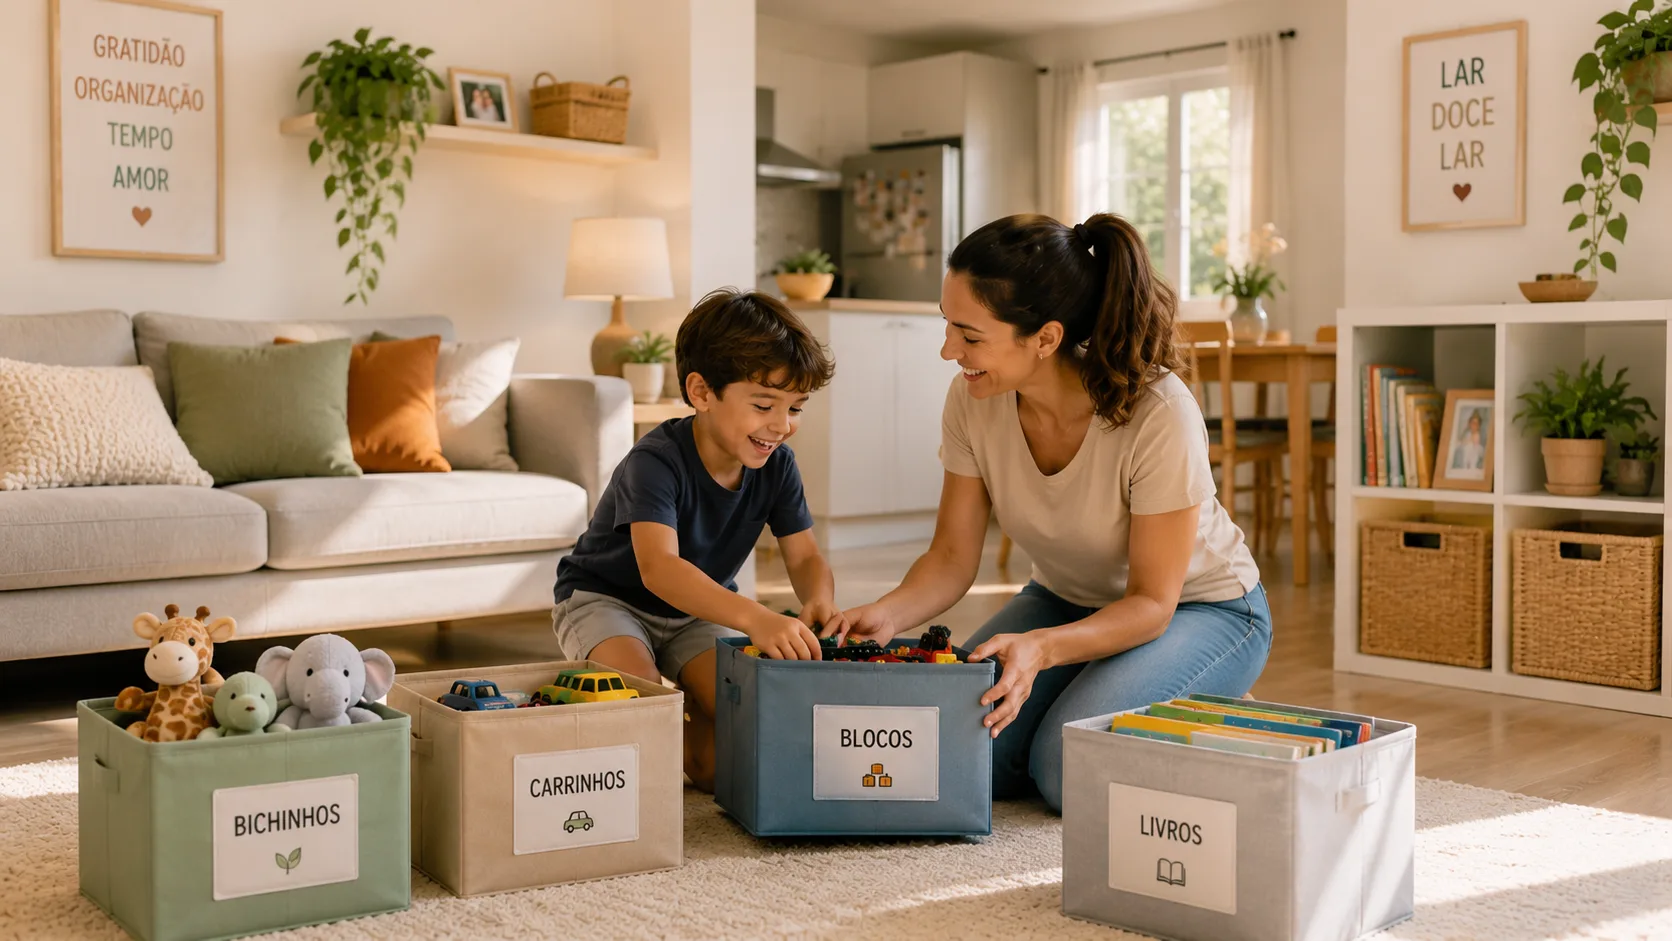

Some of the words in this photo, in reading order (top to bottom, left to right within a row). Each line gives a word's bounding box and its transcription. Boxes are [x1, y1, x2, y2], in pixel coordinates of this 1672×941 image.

[94, 34, 184, 67] GRATIDÃO
[1441, 57, 1485, 88] LAR
[74, 76, 204, 114] ORGANIZAÇÃO
[1431, 97, 1494, 130] DOCE
[107, 122, 173, 150] TEMPO
[1440, 141, 1484, 170] LAR
[113, 166, 169, 191] AMOR
[841, 729, 912, 748] BLOCOS
[530, 770, 625, 797] CARRINHOS
[235, 804, 340, 836] BICHINHOS
[1141, 815, 1202, 845] LIVROS
